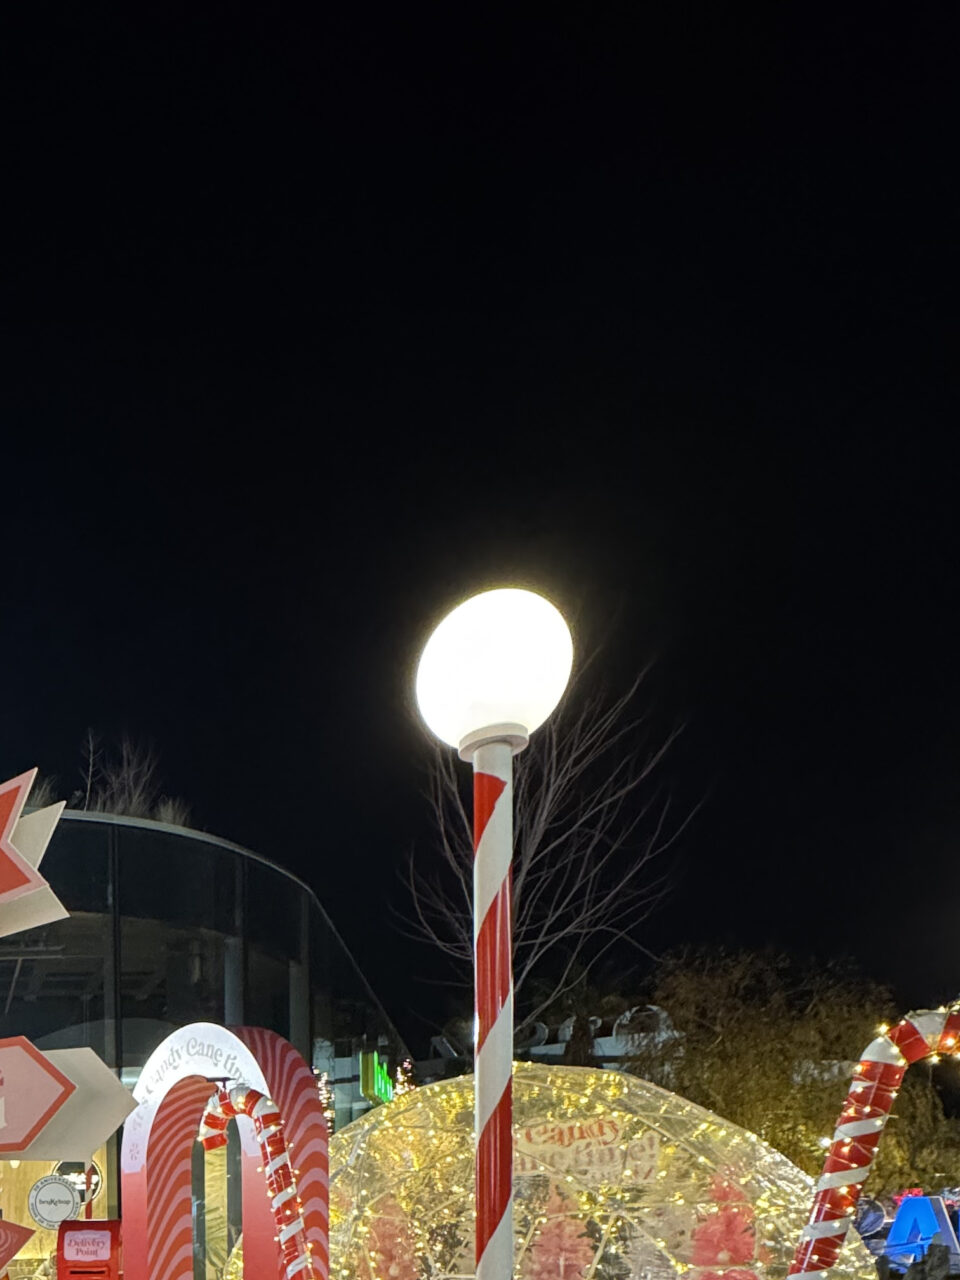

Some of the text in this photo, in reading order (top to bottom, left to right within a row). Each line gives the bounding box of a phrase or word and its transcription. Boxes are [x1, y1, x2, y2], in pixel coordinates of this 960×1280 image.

[186, 1037, 223, 1067] Cane
[68, 1238, 106, 1251] Delivery
[75, 1248, 98, 1258] Point
